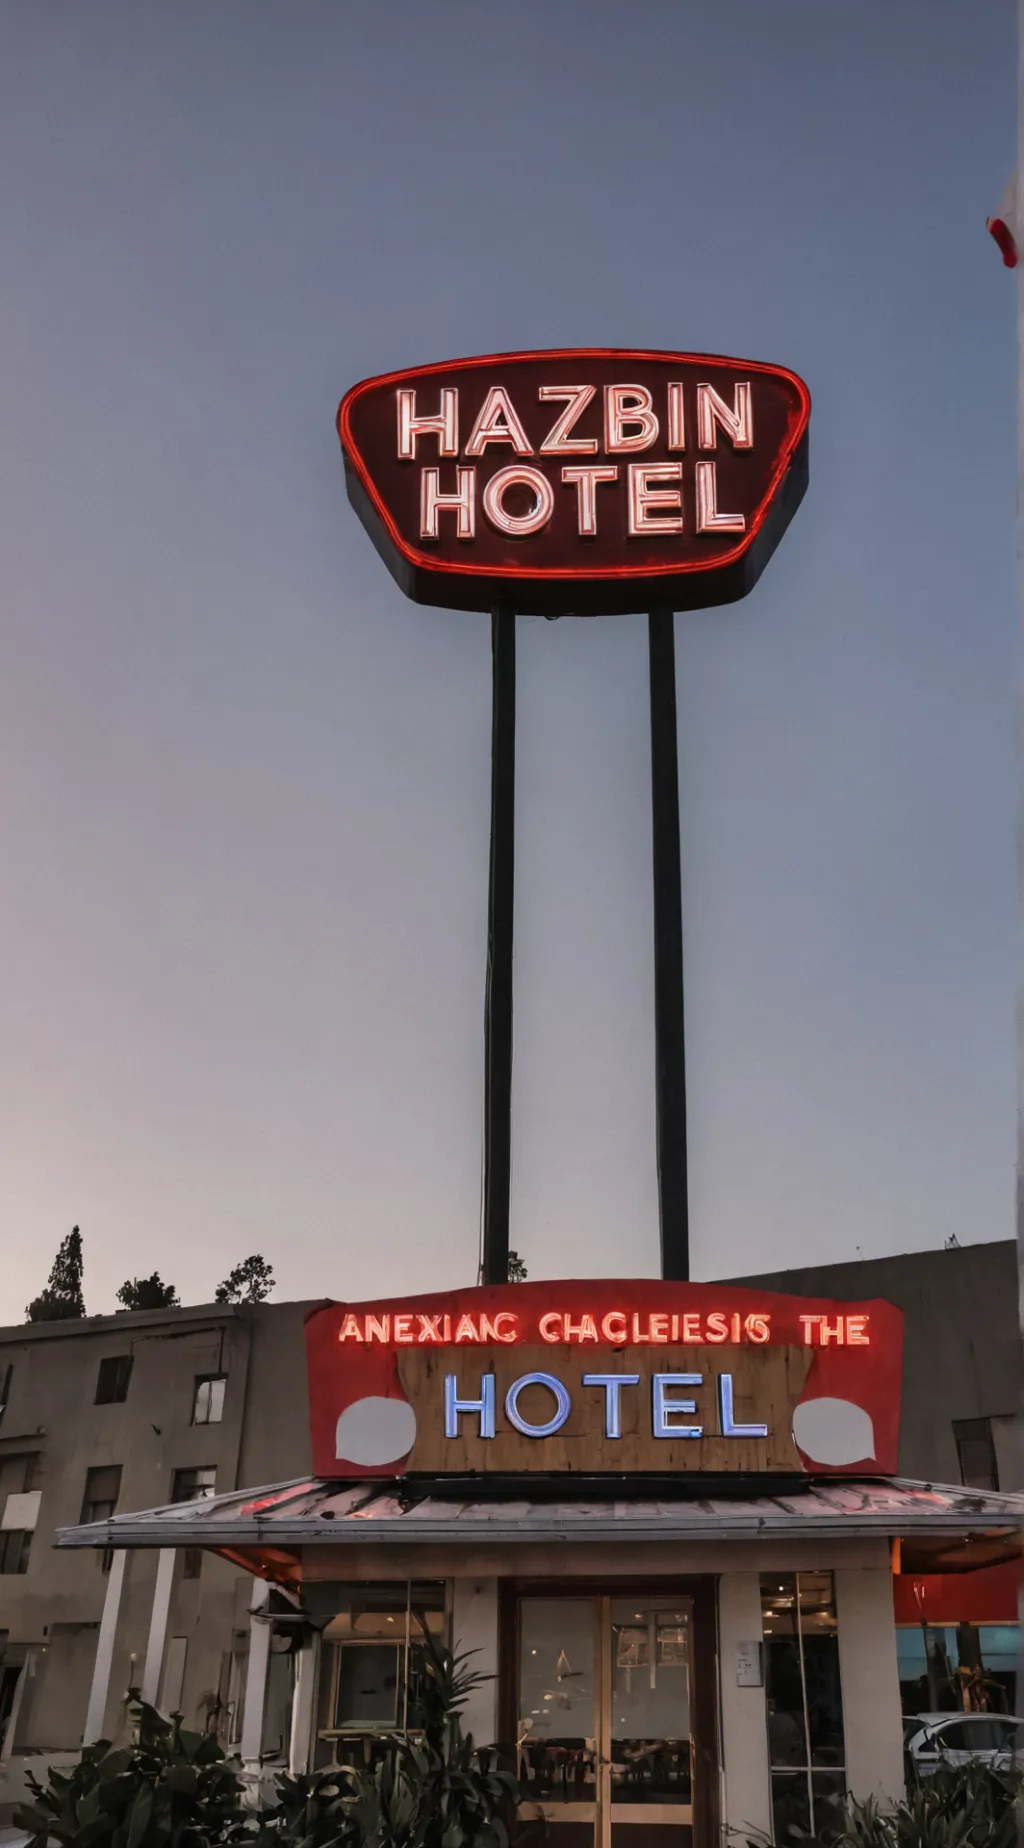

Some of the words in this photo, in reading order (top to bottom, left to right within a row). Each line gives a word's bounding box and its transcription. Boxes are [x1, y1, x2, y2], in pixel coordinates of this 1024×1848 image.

[396, 382, 754, 460] HAZBIN
[419, 462, 746, 540] HOTEL
[799, 1314, 870, 1345] THE
[444, 1372, 768, 1439] HOTEL
